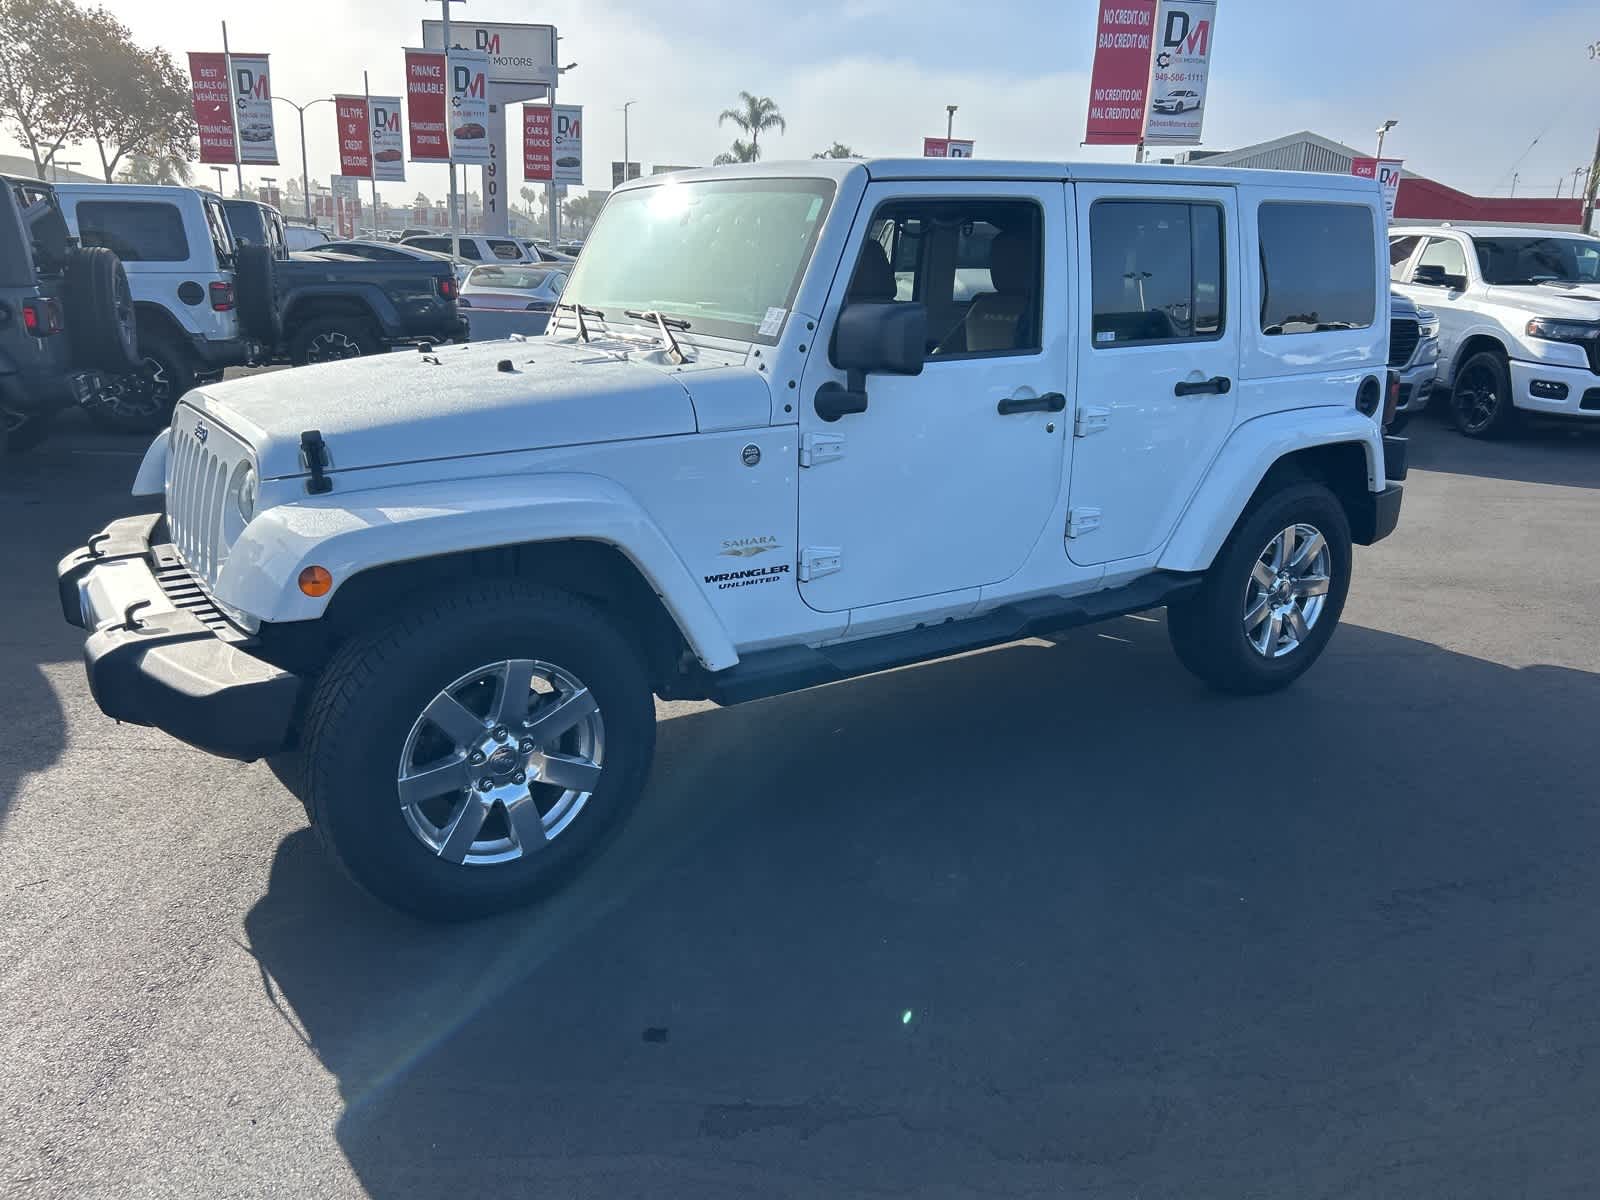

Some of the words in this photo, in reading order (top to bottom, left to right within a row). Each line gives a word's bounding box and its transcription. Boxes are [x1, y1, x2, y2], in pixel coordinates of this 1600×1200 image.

[1104, 9, 1114, 24] NO
[1115, 10, 1138, 25] CREDIT
[1163, 10, 1210, 56] DM
[1099, 33, 1114, 48] BAD
[1114, 33, 1138, 48] CREDIT
[493, 56, 533, 66] MOTORS
[200, 69, 216, 77] BEST
[411, 64, 440, 77] FINANCE
[194, 81, 216, 89] DEALS
[409, 82, 444, 94] AVAILABLE
[195, 92, 228, 102] VEHICLES
[1095, 89, 1105, 100] NO
[1105, 89, 1130, 101] CREDITO
[340, 107, 350, 118] ALL
[1091, 107, 1104, 119] MAL
[1105, 107, 1130, 120] CREDITO
[526, 115, 536, 123] WE
[537, 115, 550, 124] BUY
[200, 125, 233, 134] FINANCING
[526, 126, 543, 135] CARS
[526, 138, 550, 148] TRUCKS
[342, 155, 369, 168] WELCOME
[526, 163, 551, 171] ACCEPTED
[488, 143, 497, 213] 2901
[722, 535, 777, 549] SAHARA
[704, 564, 790, 584] WRANGLER
[718, 576, 781, 590] UNLIMITED
